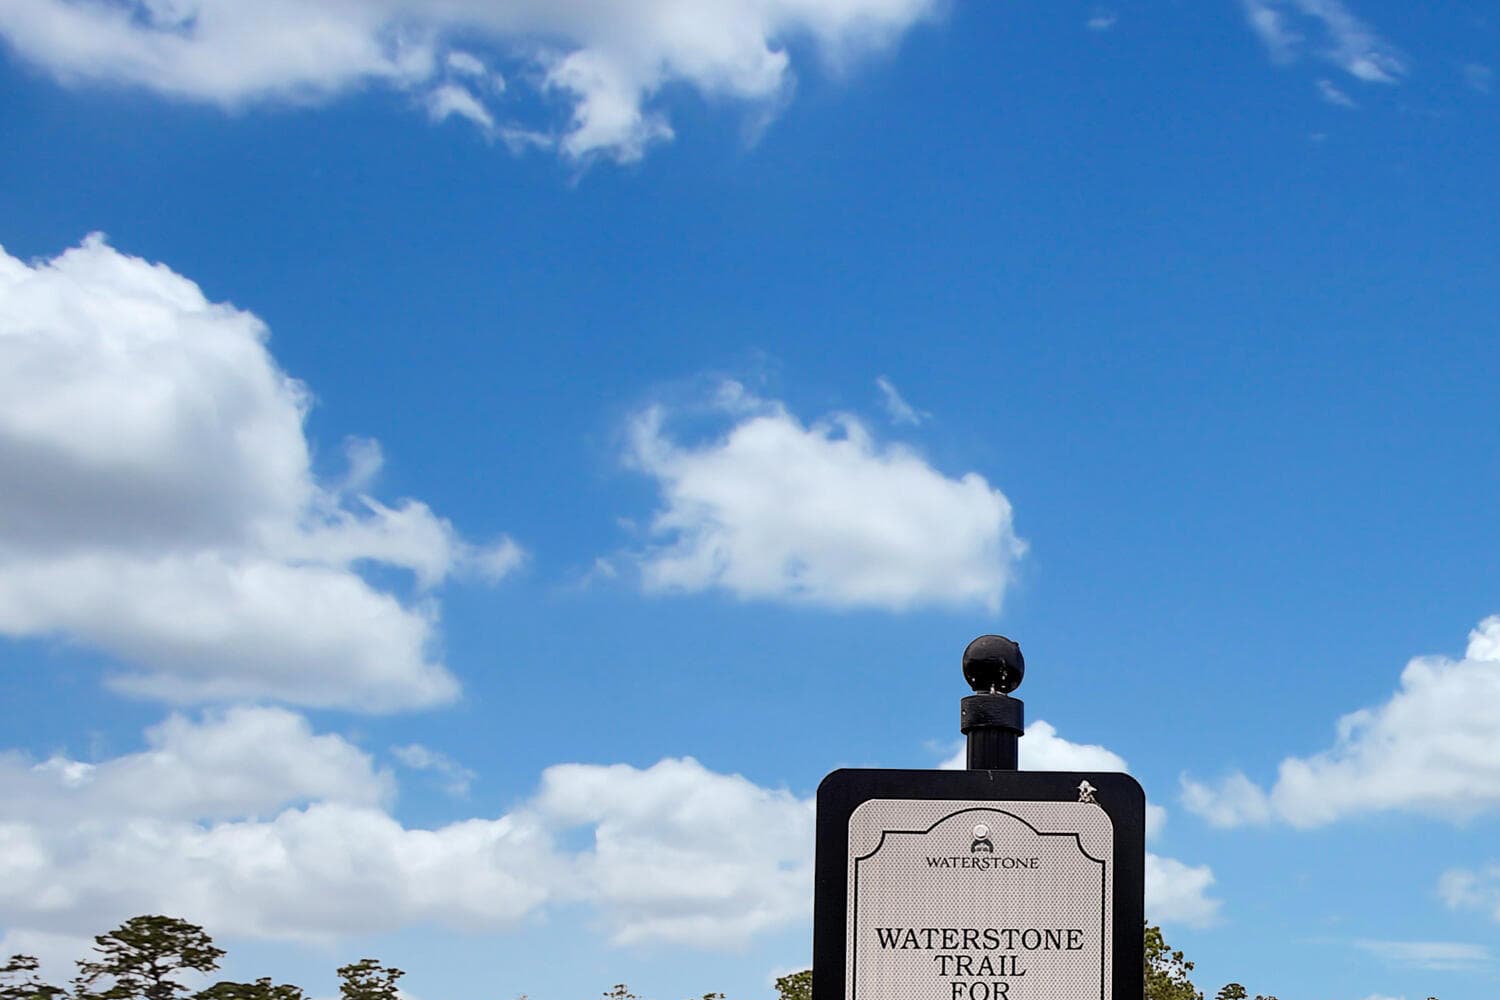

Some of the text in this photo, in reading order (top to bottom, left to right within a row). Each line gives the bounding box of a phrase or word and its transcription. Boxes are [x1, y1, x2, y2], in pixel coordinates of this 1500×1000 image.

[926, 856, 1039, 871] WATERSTONE
[875, 928, 1084, 951] WATERSTONE
[934, 955, 1026, 977] TRAIL
